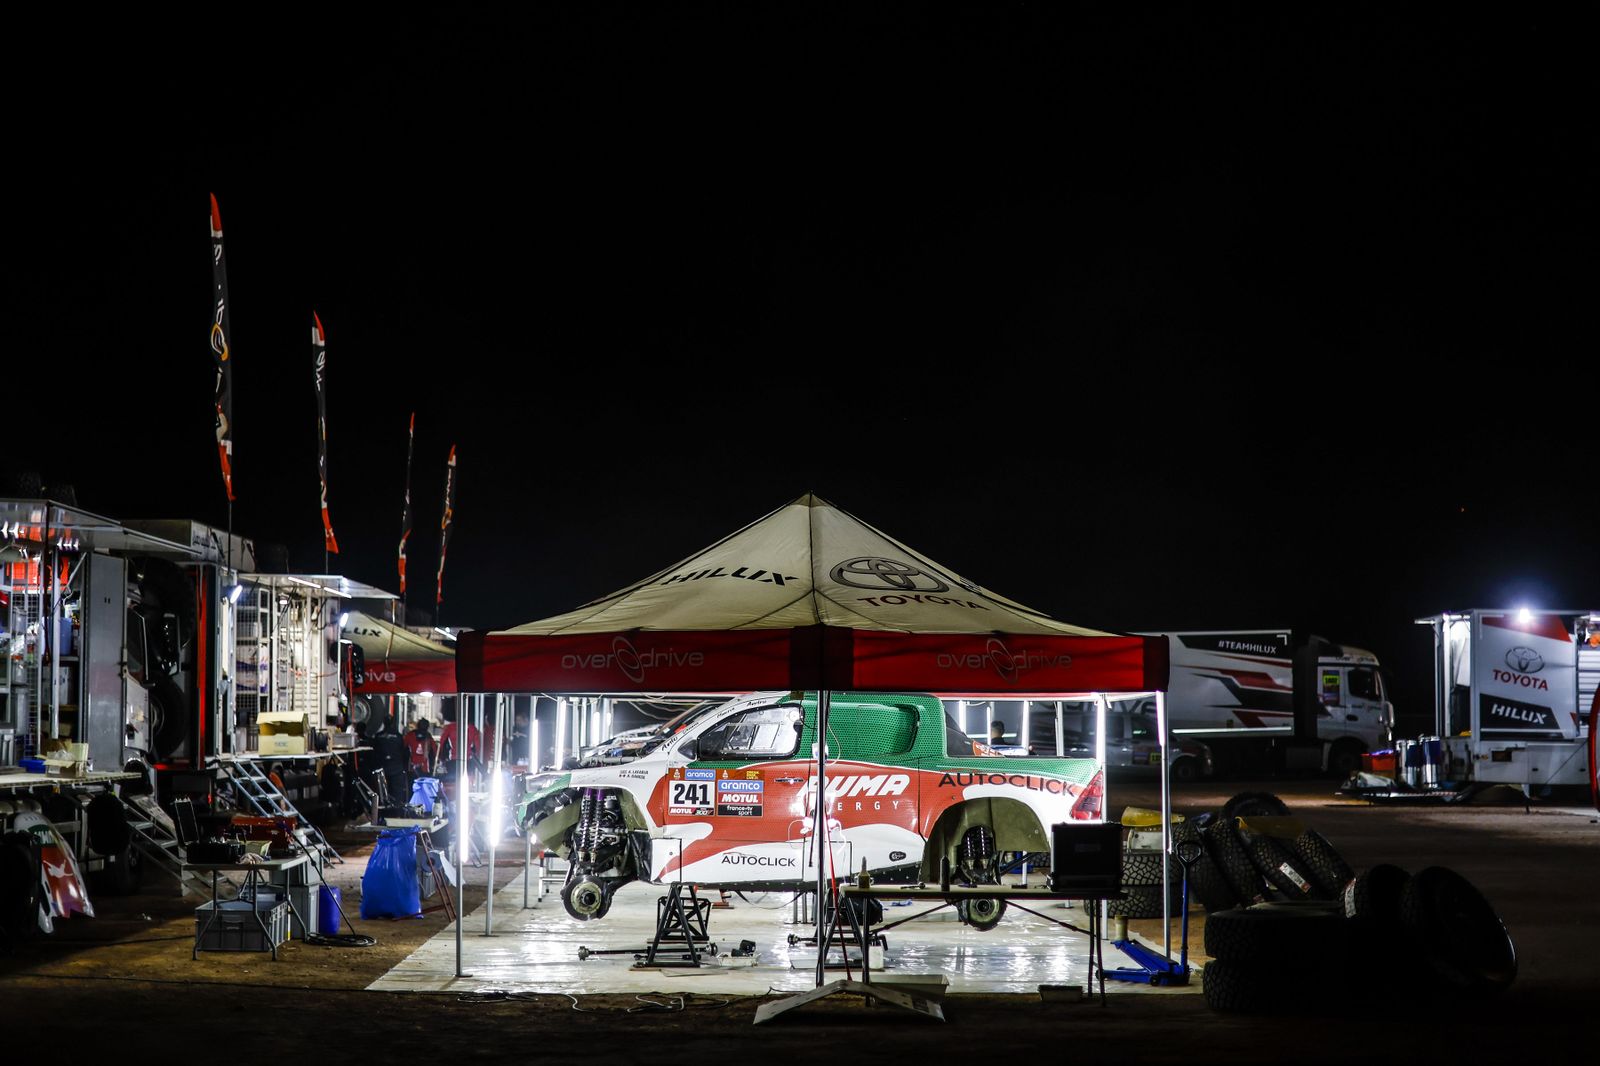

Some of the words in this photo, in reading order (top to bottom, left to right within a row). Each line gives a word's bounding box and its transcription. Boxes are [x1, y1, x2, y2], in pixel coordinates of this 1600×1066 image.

[661, 567, 799, 586] HILUX
[857, 594, 991, 612] TOYOTA
[342, 627, 381, 637] LUX
[1218, 640, 1278, 655] #TEAMHILUX
[561, 653, 614, 669] over
[639, 648, 705, 668] drive
[937, 653, 989, 669] over
[1013, 649, 1073, 669] drive
[1492, 668, 1549, 691] TOYOTA
[1491, 703, 1547, 725] HILUX
[686, 771, 714, 779] aramco
[721, 781, 760, 791] aramco
[938, 772, 1075, 798] AUTOCLICK
[673, 783, 711, 805] 241
[721, 793, 759, 803] MOTUL
[670, 807, 693, 815] MOTUL
[837, 801, 900, 811] ERGY
[721, 855, 796, 867] AUTOCLICK
